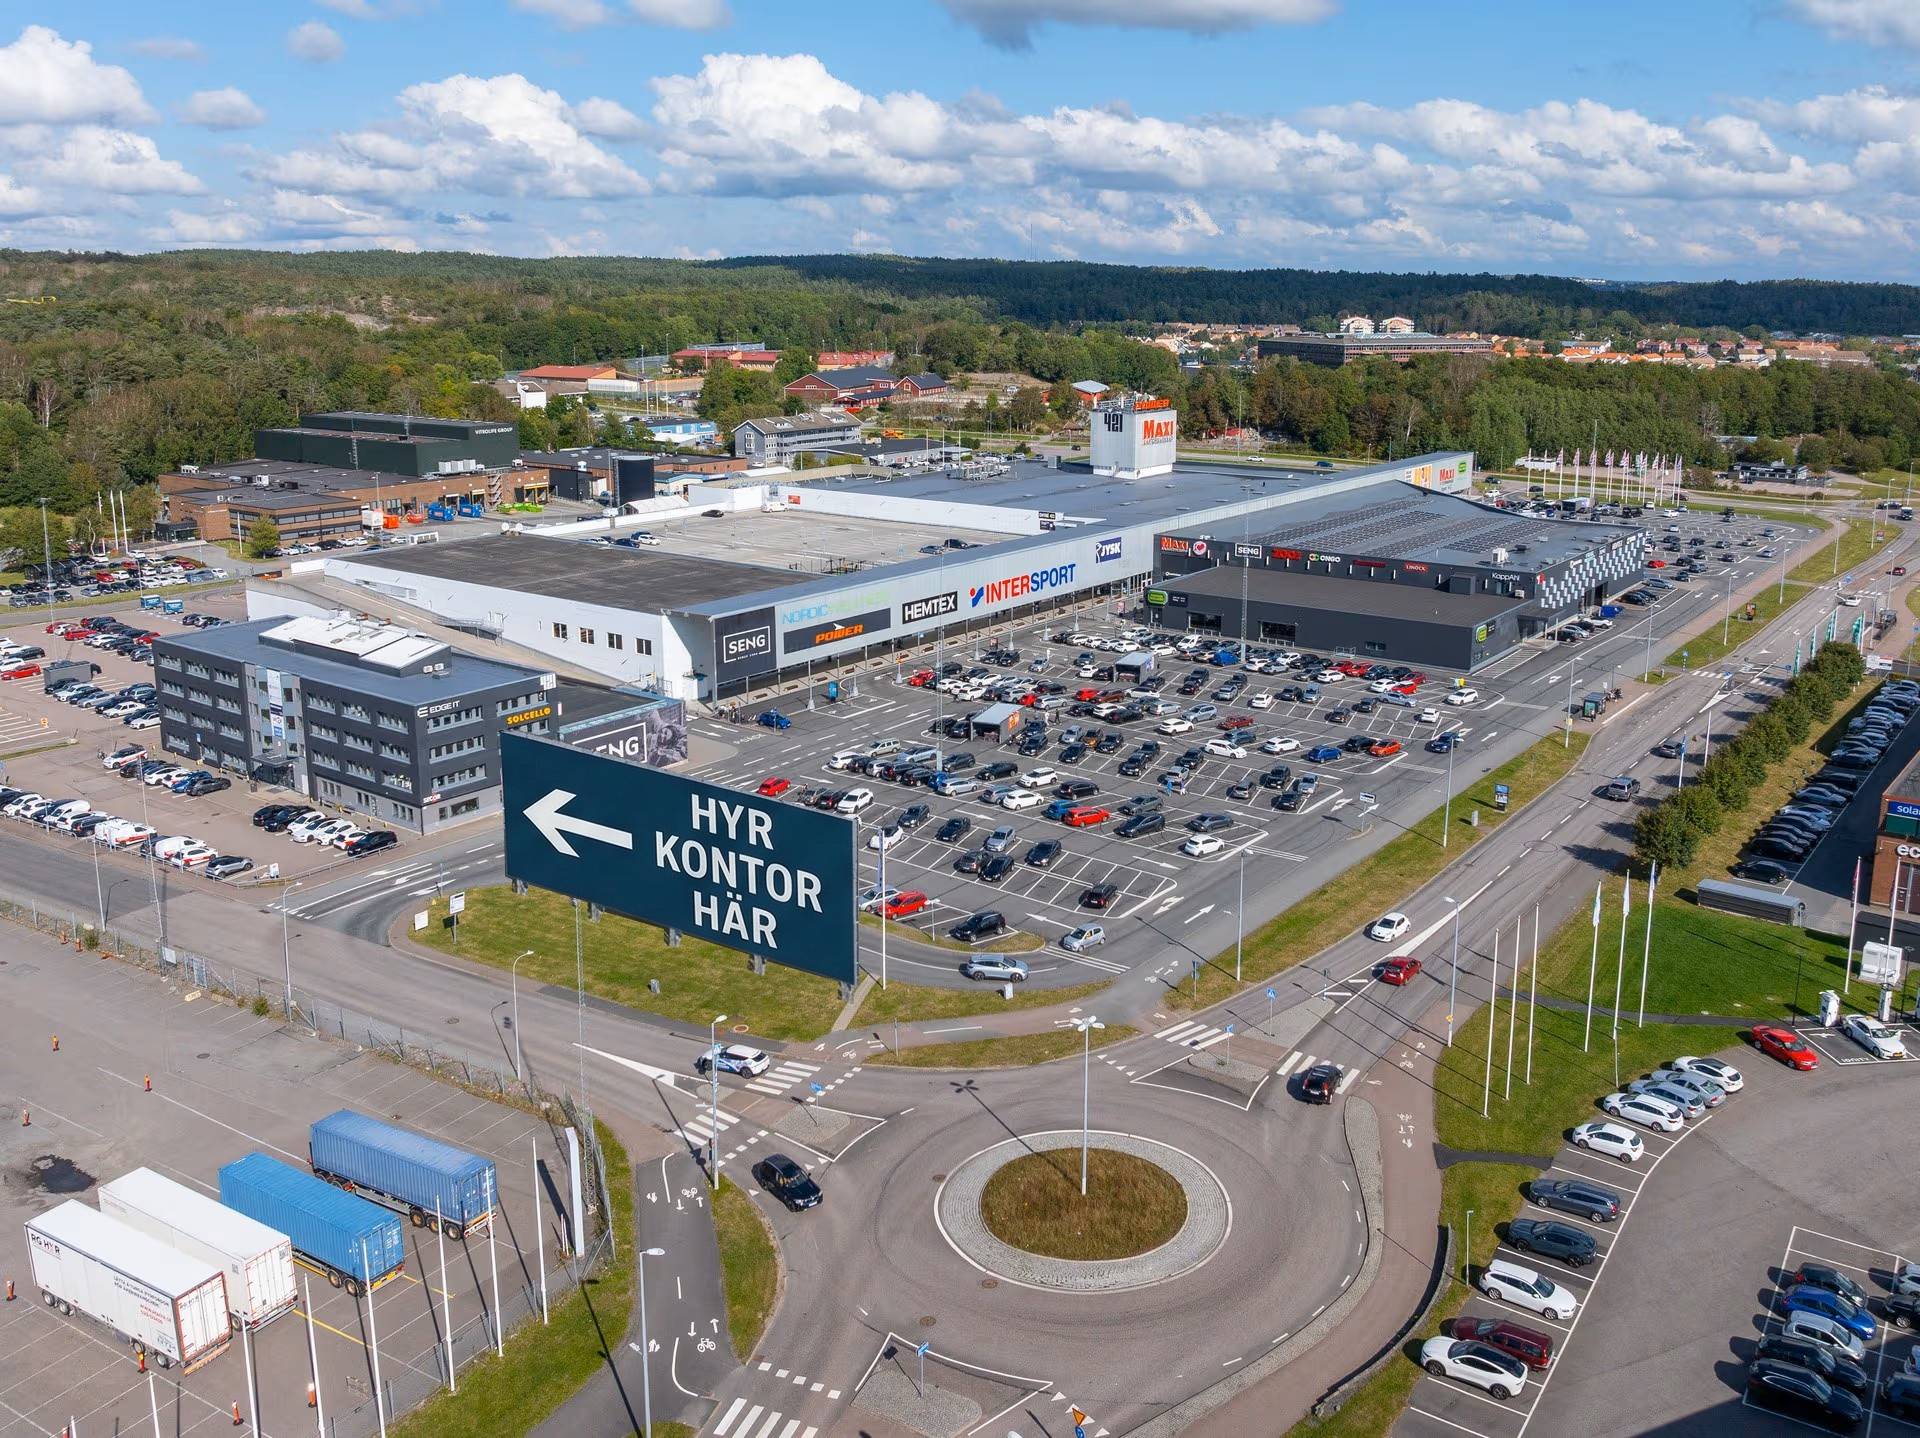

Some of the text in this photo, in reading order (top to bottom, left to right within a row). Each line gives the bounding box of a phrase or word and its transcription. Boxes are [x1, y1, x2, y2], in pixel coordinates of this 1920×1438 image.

[1100, 541, 1121, 557] JYSK
[1238, 546, 1259, 555] SENG
[986, 563, 1076, 604] INTERSPORT
[905, 593, 957, 622] HEMTEX
[728, 634, 766, 654] SENG
[815, 624, 864, 644] POWER
[429, 703, 452, 714] EDGE
[506, 707, 552, 725] SOLCELLO
[595, 736, 639, 758] NG
[691, 793, 774, 850] HYR
[656, 830, 823, 914] KONTOR
[693, 890, 778, 949] HÄR
